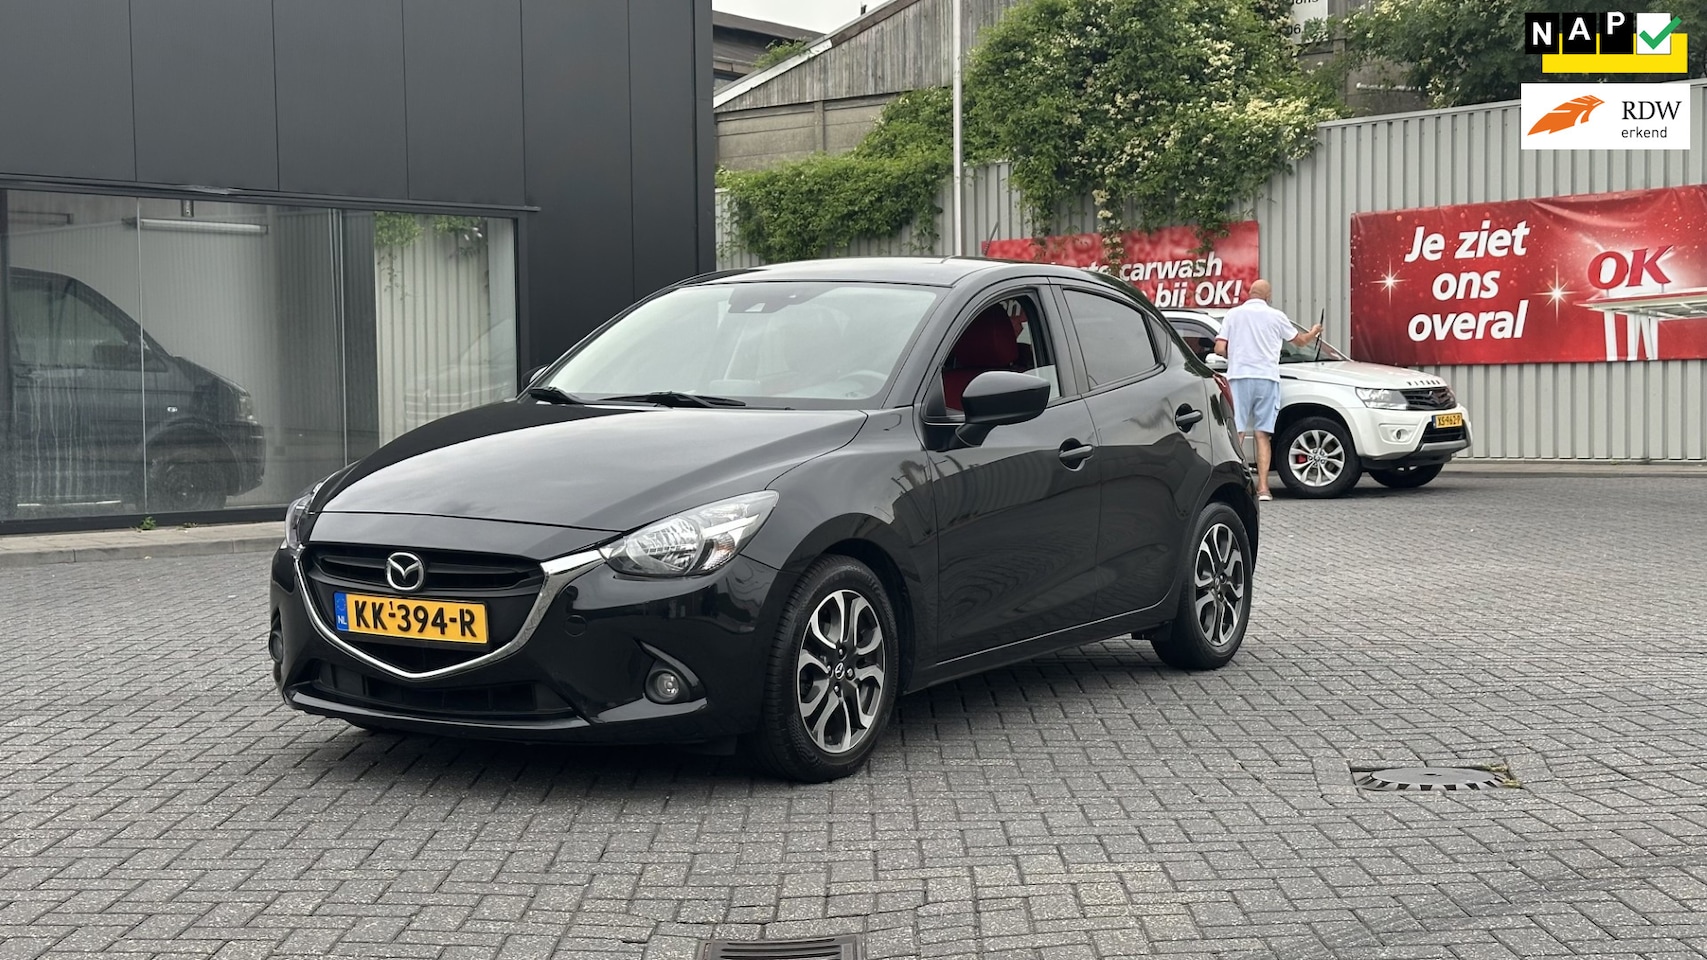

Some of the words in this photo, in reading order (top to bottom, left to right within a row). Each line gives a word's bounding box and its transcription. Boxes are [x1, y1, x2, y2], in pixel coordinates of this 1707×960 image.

[1404, 225, 1445, 263] Je
[1454, 219, 1530, 259] ziet
[1120, 251, 1223, 281] carwash
[1587, 245, 1674, 290] OK
[1195, 279, 1243, 306] OK!
[1432, 270, 1500, 301] ons
[1408, 299, 1529, 342] overal
[337, 615, 347, 625] NL
[354, 600, 477, 637] KK-394-R
